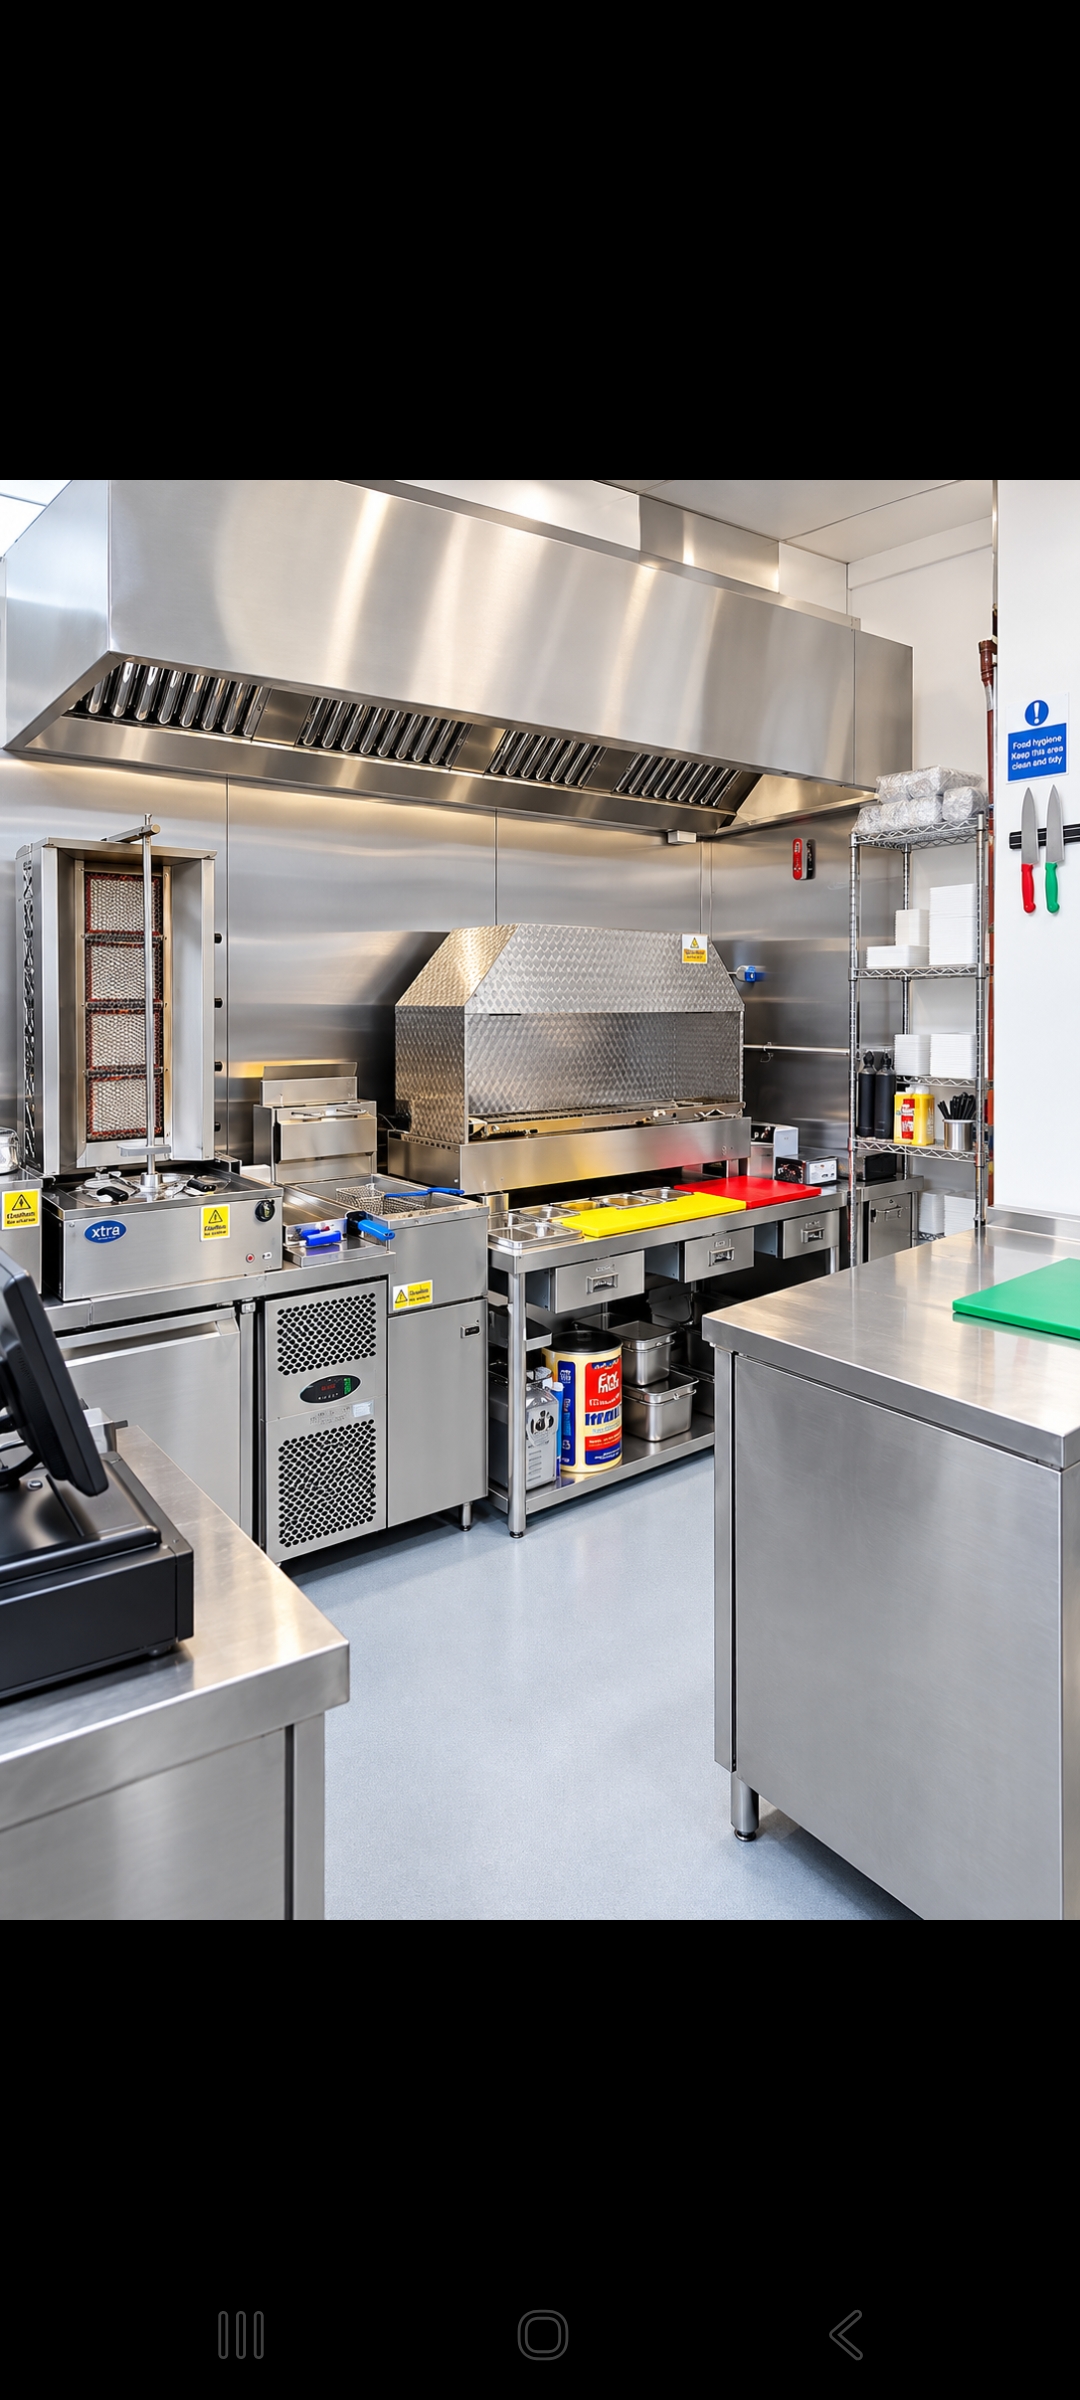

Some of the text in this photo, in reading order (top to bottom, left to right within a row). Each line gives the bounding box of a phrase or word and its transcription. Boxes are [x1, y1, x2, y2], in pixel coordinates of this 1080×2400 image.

[1012, 739, 1031, 750] Food
[1012, 761, 1031, 770] clean
[1033, 758, 1047, 767] and
[91, 1225, 120, 1239] xtra
